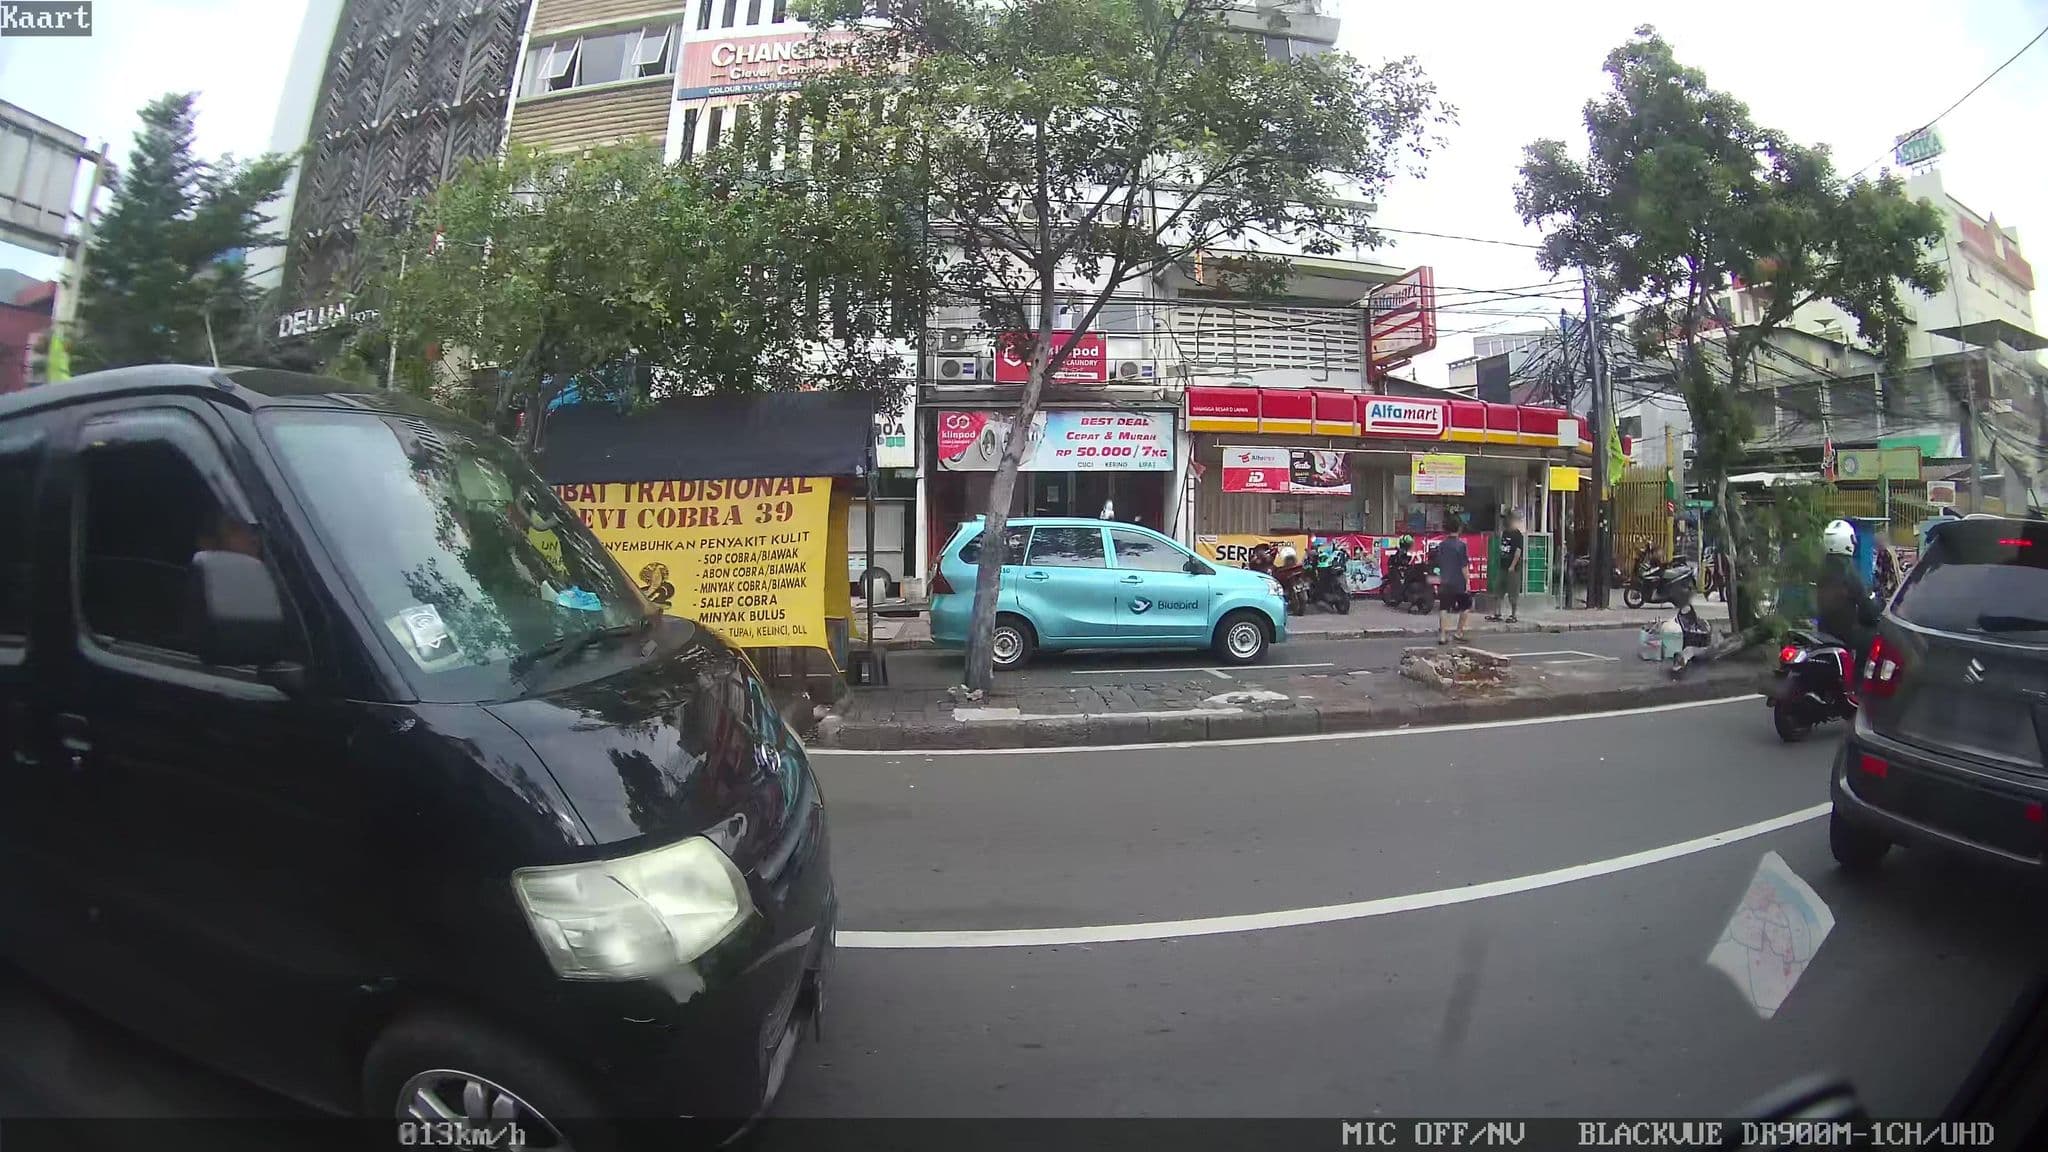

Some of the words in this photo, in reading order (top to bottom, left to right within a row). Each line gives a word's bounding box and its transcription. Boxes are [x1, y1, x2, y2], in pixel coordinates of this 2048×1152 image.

[1371, 404, 1438, 421] Alfamart
[1081, 418, 1113, 426] BEST
[1117, 418, 1149, 426] DEAL
[941, 431, 976, 440] klinpod
[1104, 431, 1113, 441] &
[556, 481, 607, 503] BAT
[623, 476, 813, 504] TRADISIONAL
[578, 508, 628, 530] EVI
[637, 504, 743, 529] COBRA
[755, 500, 793, 524] 39
[600, 541, 696, 552] NYEMBUHKAN
[700, 535, 767, 549] PENYAKIT
[771, 531, 809, 545] KULIT
[704, 553, 722, 565] SOP
[724, 547, 799, 564] COBRA/BIAWAK
[702, 568, 730, 579] ABON
[732, 561, 807, 577] COBRA/BIAWAK
[699, 582, 735, 594] MINYAK
[737, 577, 807, 592] COBRA/BIAWAK
[700, 596, 734, 608] SALEP
[737, 594, 778, 607] COBRA
[1158, 600, 1199, 610] Bluebird
[699, 611, 746, 623] MINYAK
[749, 608, 786, 621] BULUS
[792, 624, 808, 635] DLL
